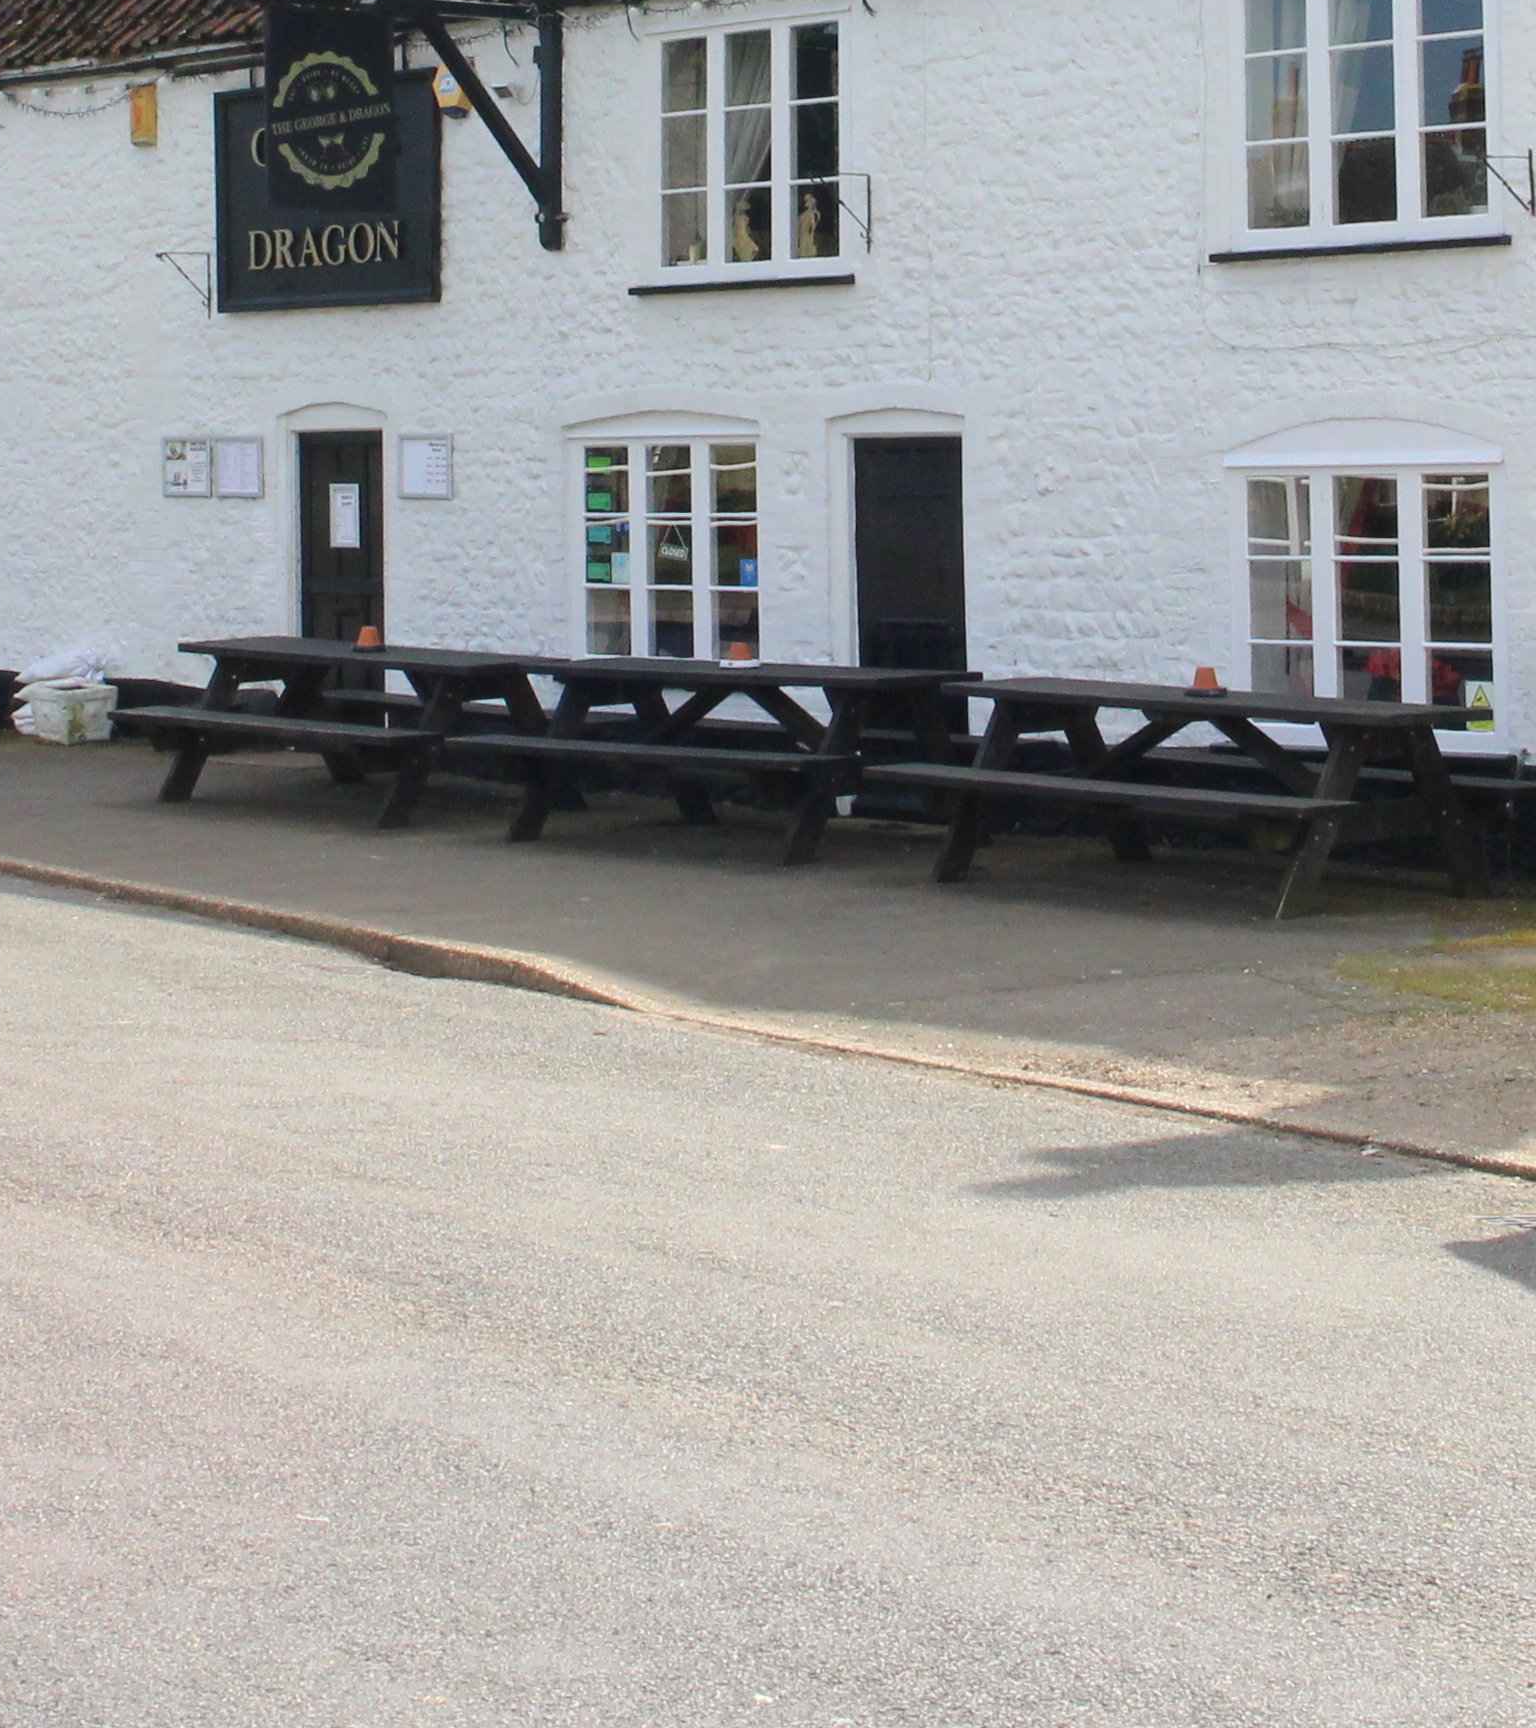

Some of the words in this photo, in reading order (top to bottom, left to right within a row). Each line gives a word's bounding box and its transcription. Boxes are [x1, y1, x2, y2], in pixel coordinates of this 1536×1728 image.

[272, 121, 293, 135] THE
[294, 113, 338, 130] GEORGE
[339, 111, 347, 123] &
[348, 102, 391, 122] DRAGON
[248, 220, 399, 270] DRAGON
[661, 546, 686, 558] CLOSED
